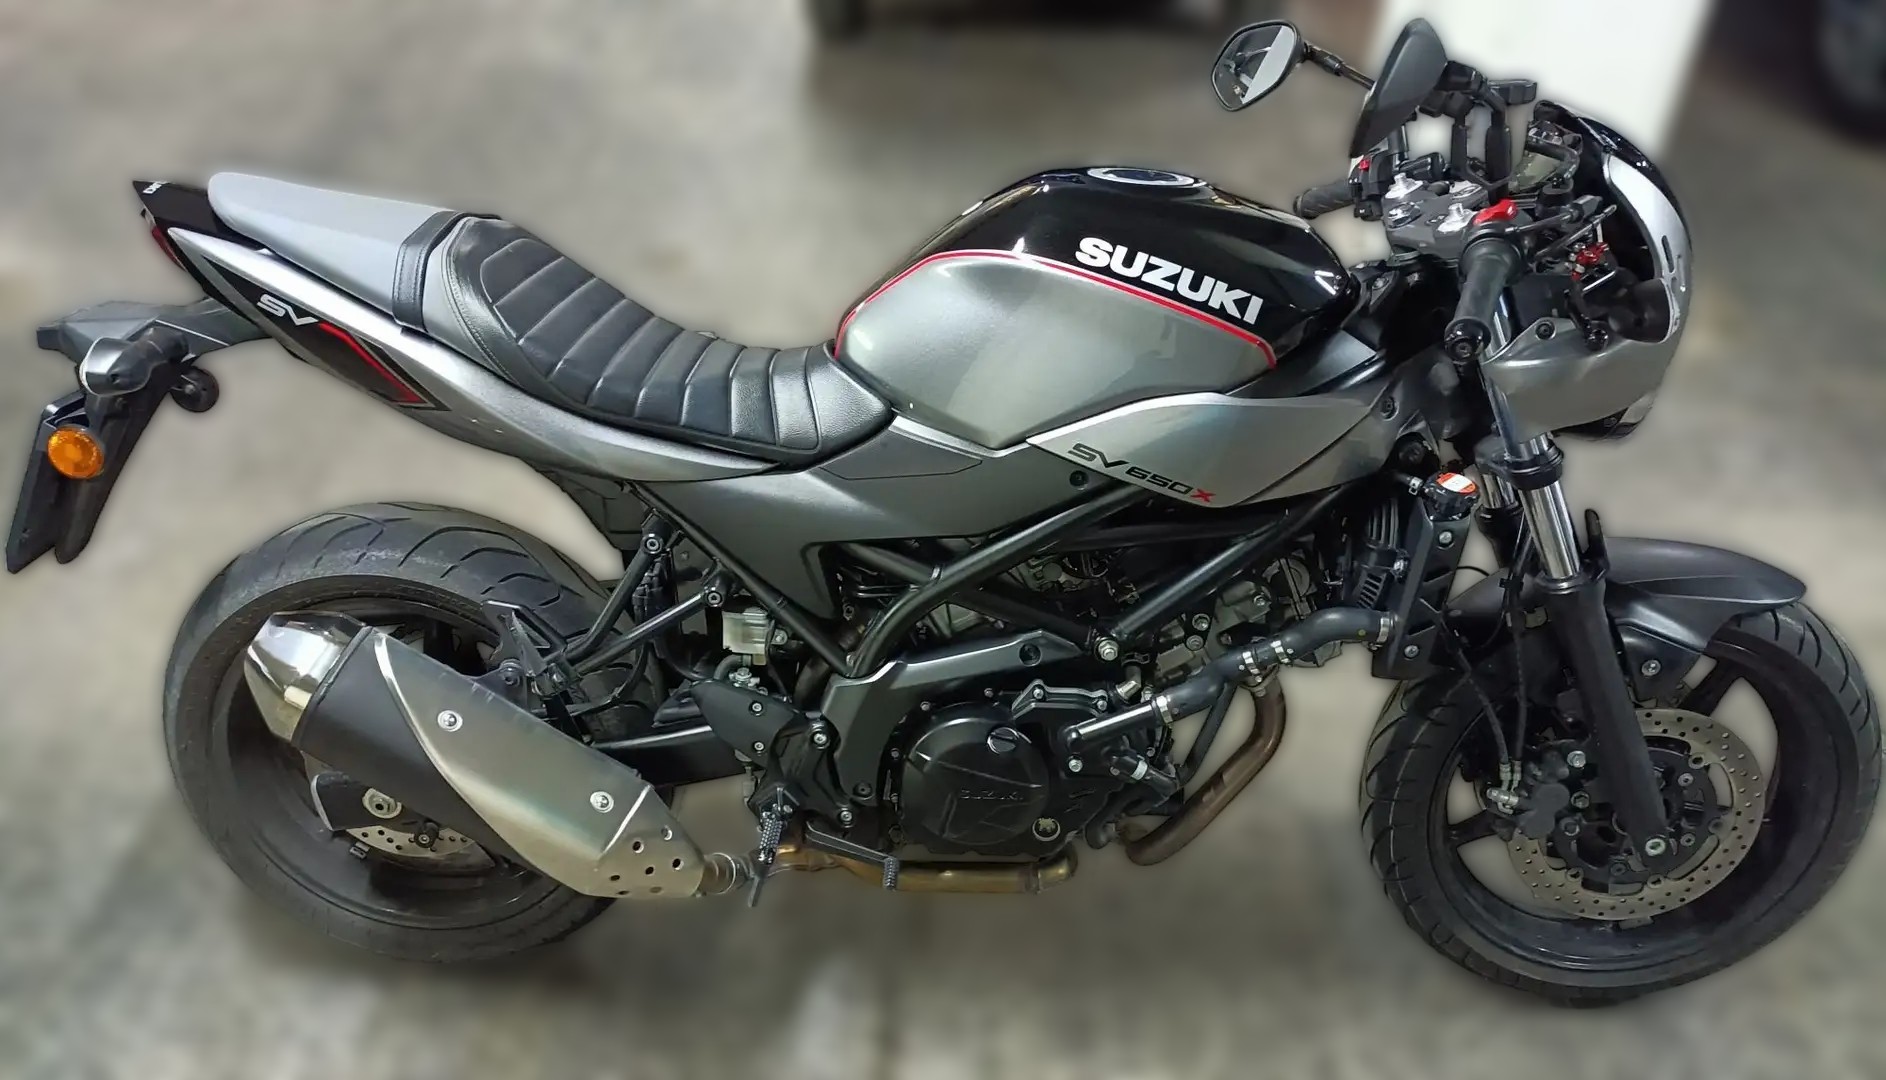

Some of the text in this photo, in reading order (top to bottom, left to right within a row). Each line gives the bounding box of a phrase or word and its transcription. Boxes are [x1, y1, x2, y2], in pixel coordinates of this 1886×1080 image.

[1075, 237, 1264, 325] SUZUKI
[257, 293, 319, 325] SV
[960, 789, 1024, 801] SUZUKI
